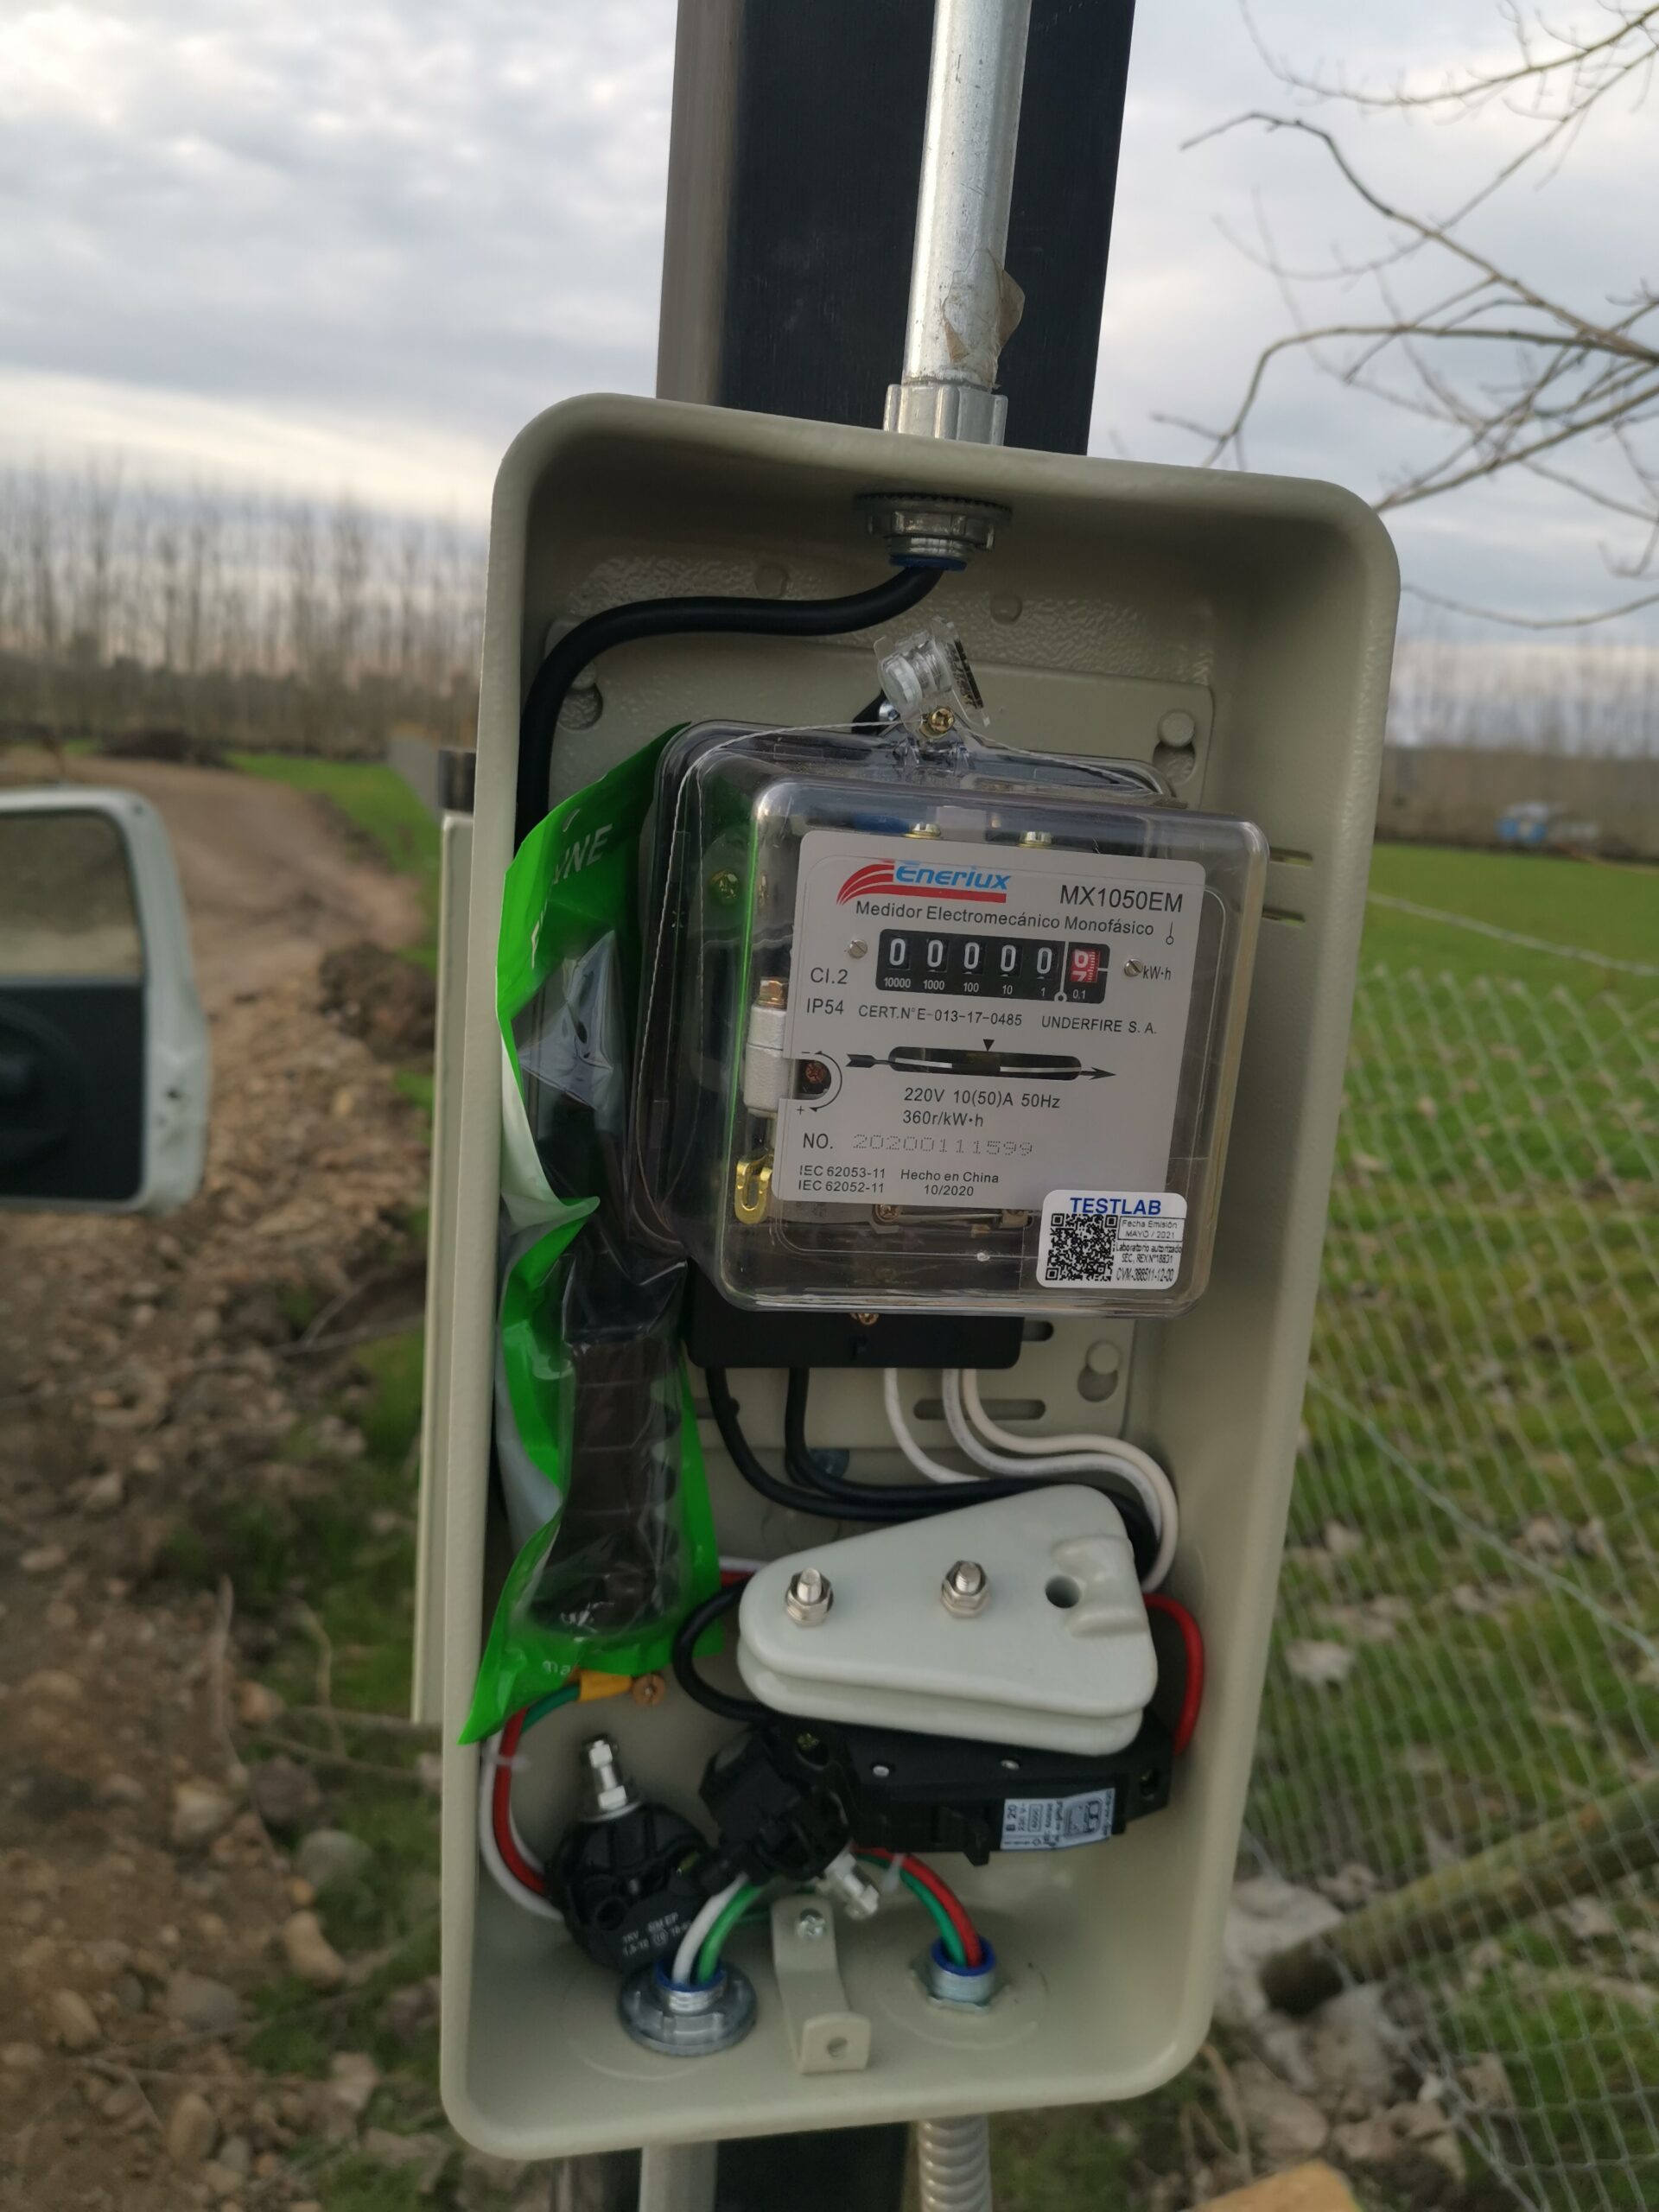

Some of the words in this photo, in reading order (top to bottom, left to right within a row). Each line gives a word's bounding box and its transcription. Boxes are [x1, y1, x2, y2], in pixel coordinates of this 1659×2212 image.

[1060, 884, 1183, 913] MX1050EM
[855, 900, 923, 919] Medidor
[926, 906, 1060, 929] Electromecánico
[1065, 916, 1154, 936] Monofásico
[883, 976, 912, 988] 10000
[923, 979, 945, 991] 1000
[963, 982, 980, 993] 100
[1001, 984, 1014, 995] 10
[1040, 987, 1046, 997] 1
[806, 997, 844, 1015] IP54
[1041, 1015, 1122, 1033] UNDERFIRE
[904, 1087, 945, 1103] 220V
[953, 1090, 1014, 1107] 10(50)A
[1020, 1092, 1061, 1109] 50Hz
[802, 1132, 834, 1150] NO.
[852, 1134, 1033, 1156] 20200111599
[799, 1165, 823, 1177] IEC
[826, 1166, 886, 1179] 62053-11
[900, 1169, 941, 1182] Hecho
[944, 1173, 961, 1182] en
[963, 1172, 1000, 1184] China
[798, 1179, 822, 1192] IEC
[824, 1180, 885, 1193] 62052-11
[924, 1184, 975, 1197] 10/2020
[1070, 1197, 1161, 1216] TESTLAB
[1122, 1219, 1146, 1228] Fecha
